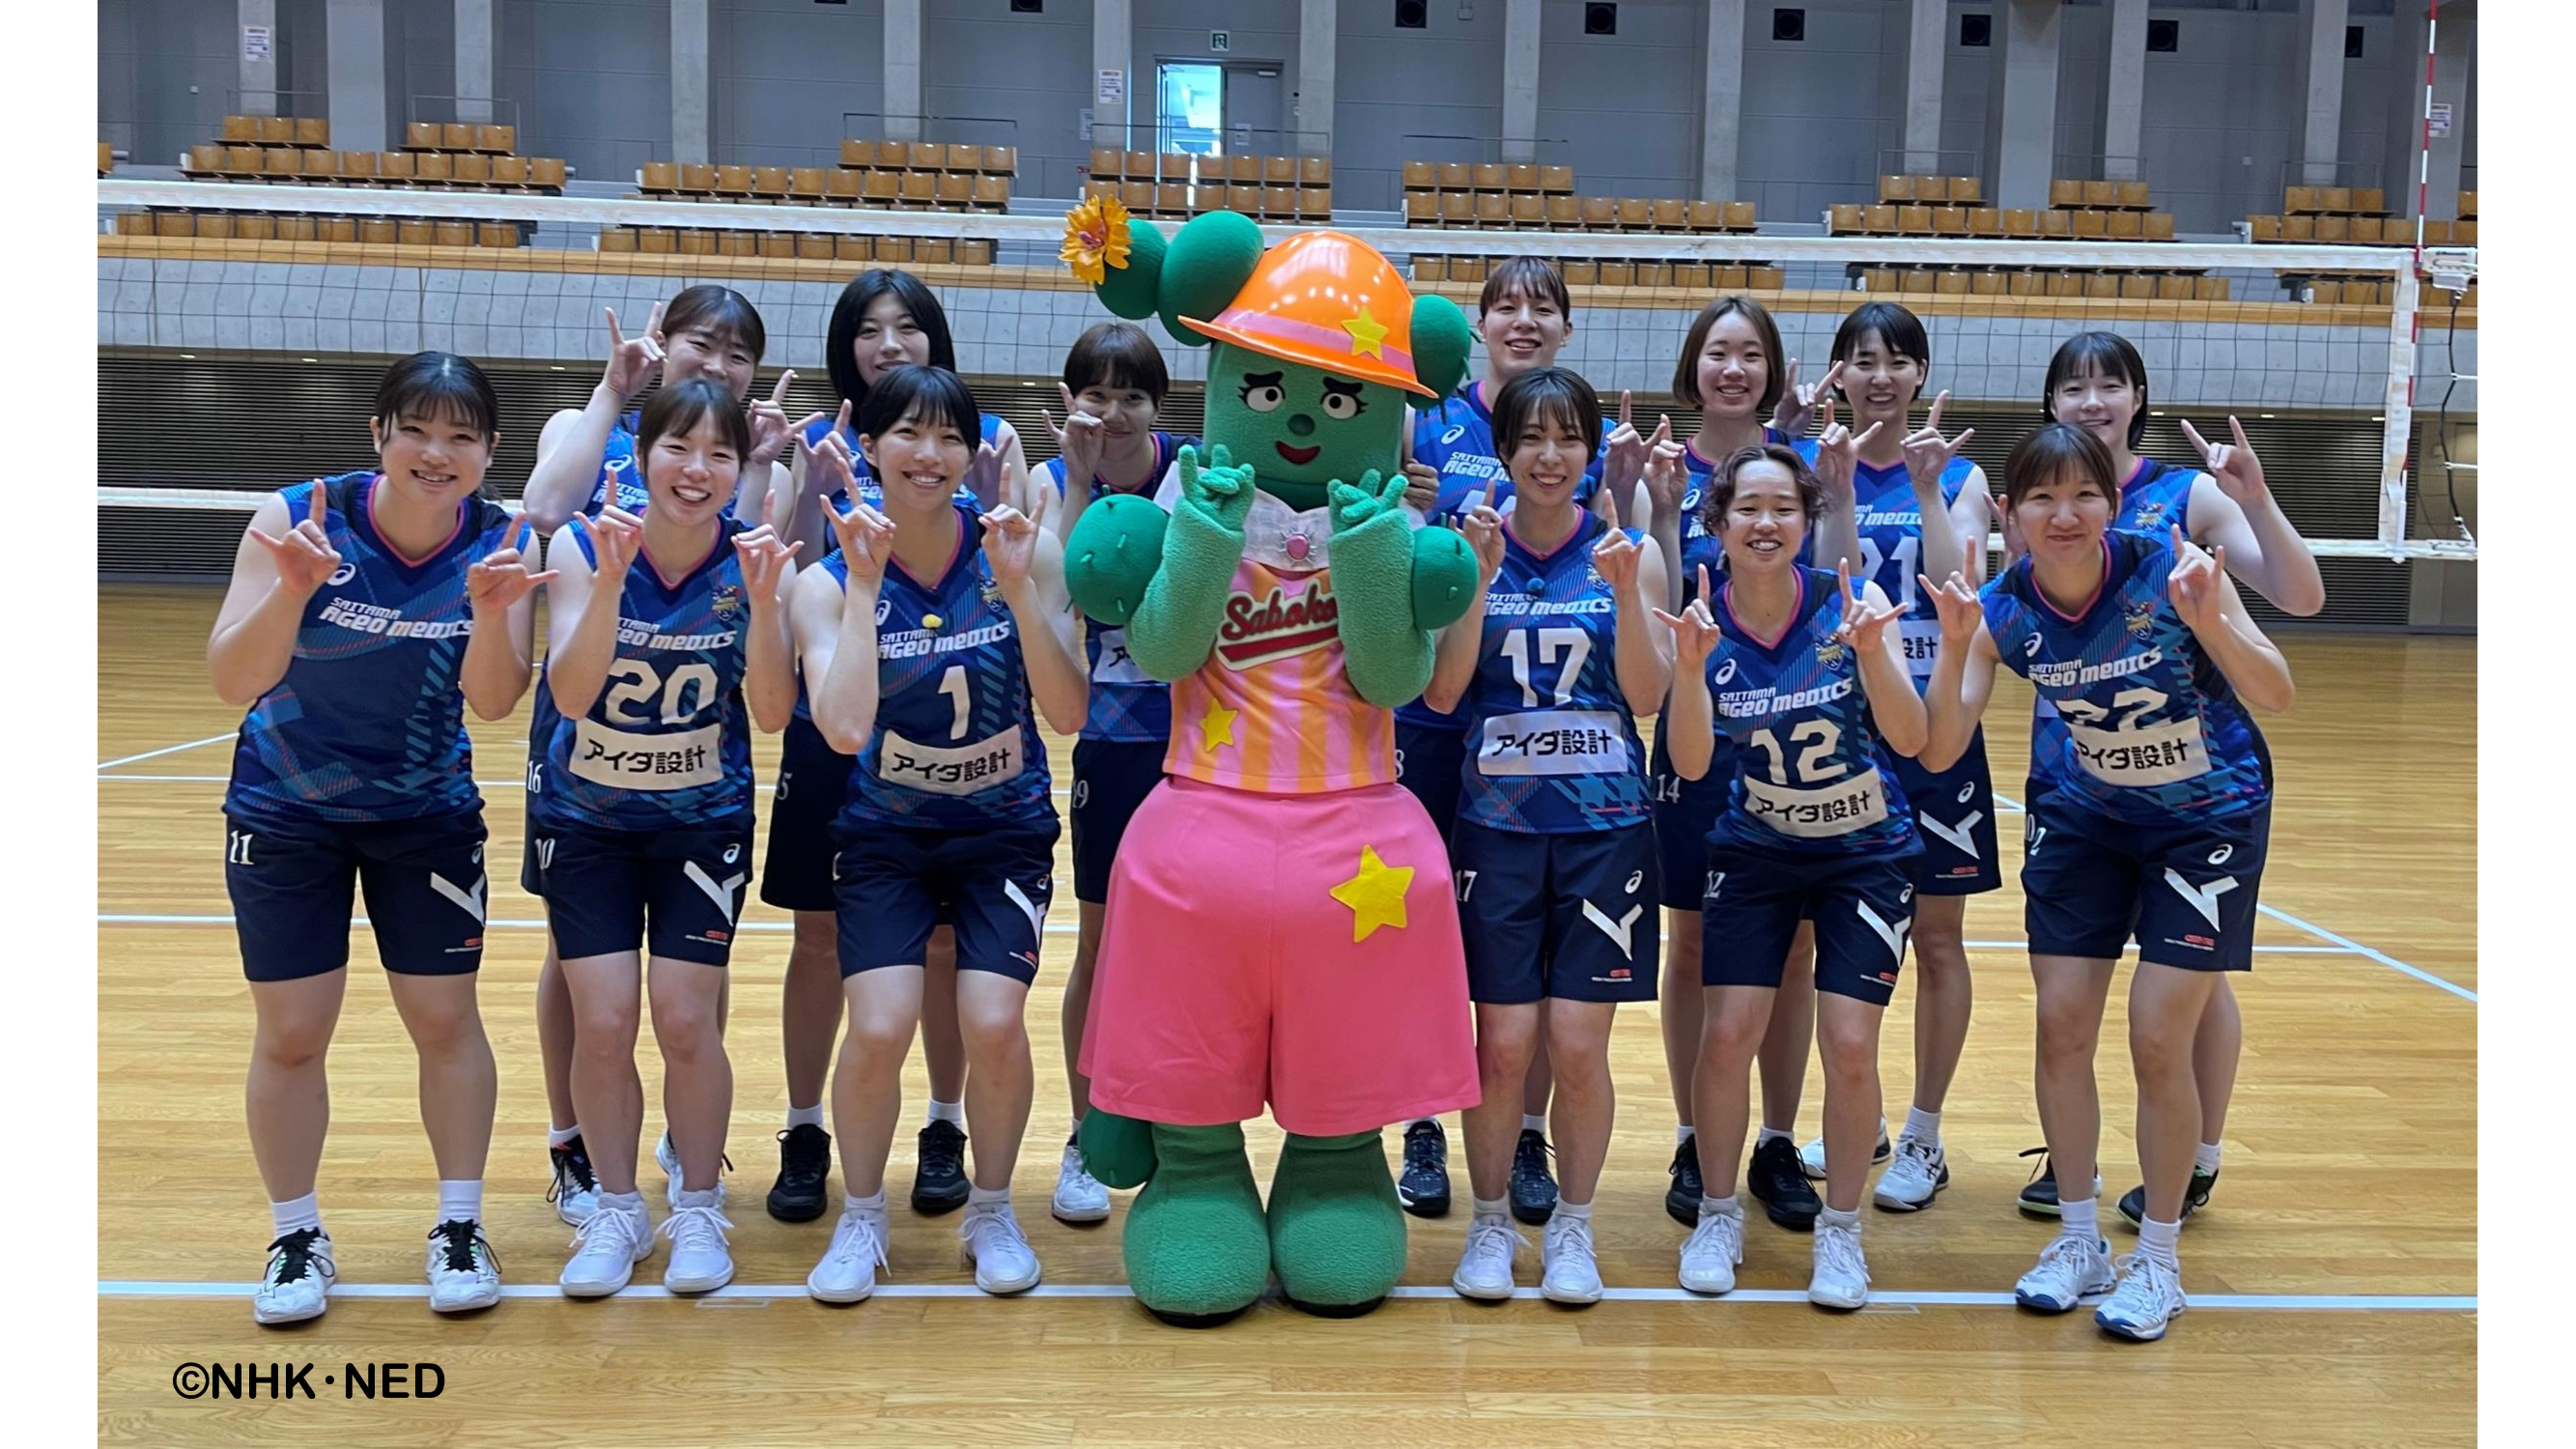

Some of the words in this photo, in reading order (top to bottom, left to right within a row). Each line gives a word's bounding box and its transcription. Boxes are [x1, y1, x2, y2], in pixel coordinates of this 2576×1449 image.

[330, 596, 402, 620] SAITAMA
[1500, 628, 1592, 708] 17
[2028, 659, 2082, 674] SAITAMA
[606, 657, 719, 725] 20
[938, 665, 972, 741] 1
[1718, 686, 1777, 703] SAITAMA
[2054, 686, 2169, 733] 22
[583, 738, 706, 775] アイダ設計
[1491, 728, 1612, 757] アイダ設計
[1750, 718, 1848, 785] 12
[2077, 737, 2189, 772] アイダ設計
[527, 760, 544, 794] 16
[891, 747, 1012, 783] アイダ設計
[1656, 774, 1681, 804] 14
[1755, 789, 1872, 823] アイダ設計
[229, 830, 255, 866] 11
[1456, 869, 1478, 903] 17
[1703, 869, 1726, 899] 12
